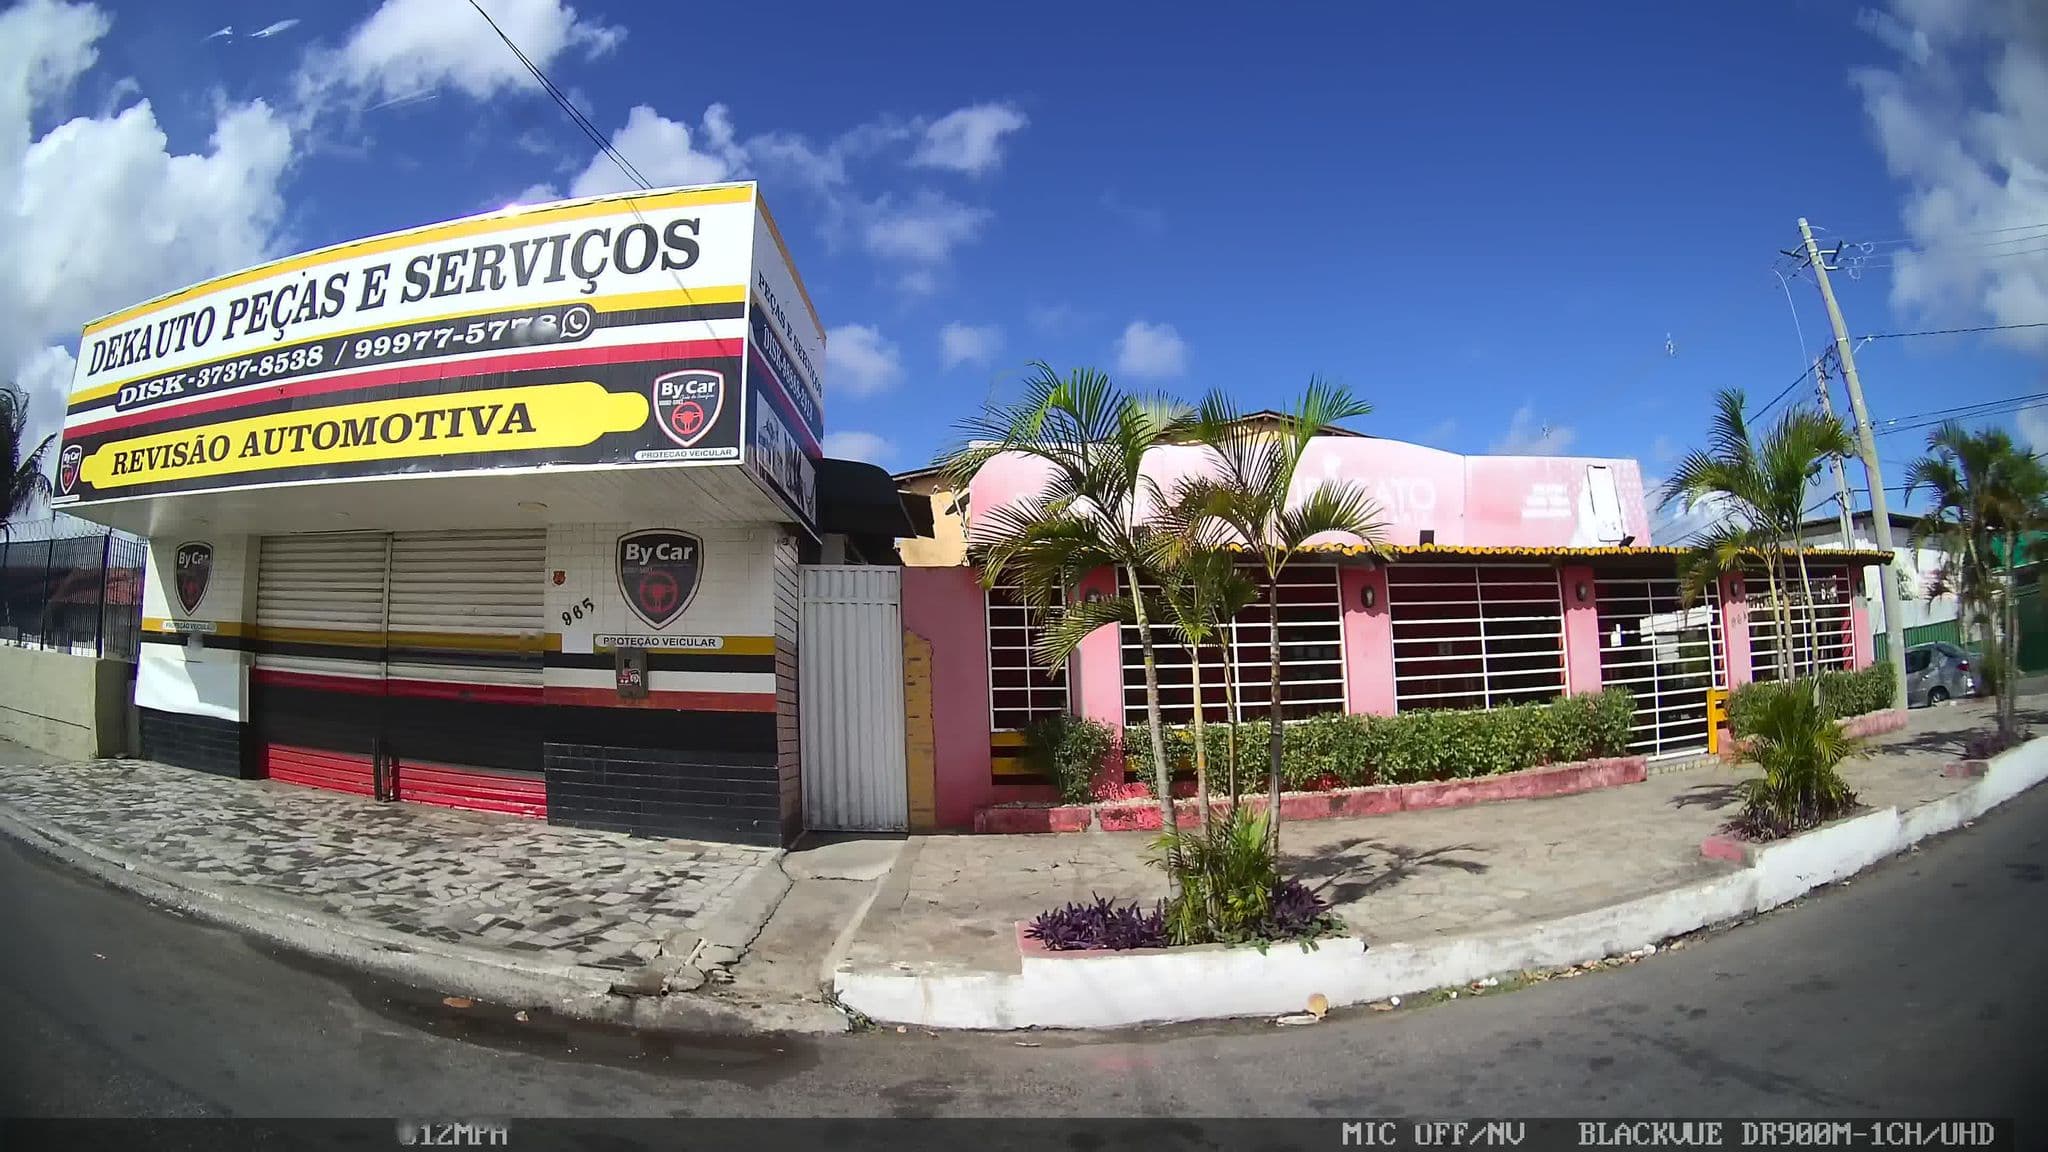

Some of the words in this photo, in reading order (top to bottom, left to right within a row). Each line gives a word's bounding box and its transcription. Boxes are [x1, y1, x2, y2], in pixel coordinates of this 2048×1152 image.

[87, 305, 216, 377] DEKAUTO
[221, 271, 350, 341] PEÇAS
[355, 262, 391, 313] E
[400, 217, 701, 305] SERVIÇOS
[661, 382, 684, 399] By
[685, 380, 716, 394] Car
[111, 434, 231, 476] REVISÃO
[238, 402, 537, 459] AUTOMOTIVA
[689, 448, 733, 457] VEICULAR
[178, 551, 191, 568] By
[625, 543, 654, 566] By
[655, 543, 694, 561] Car
[661, 636, 717, 648] VEICULAR
